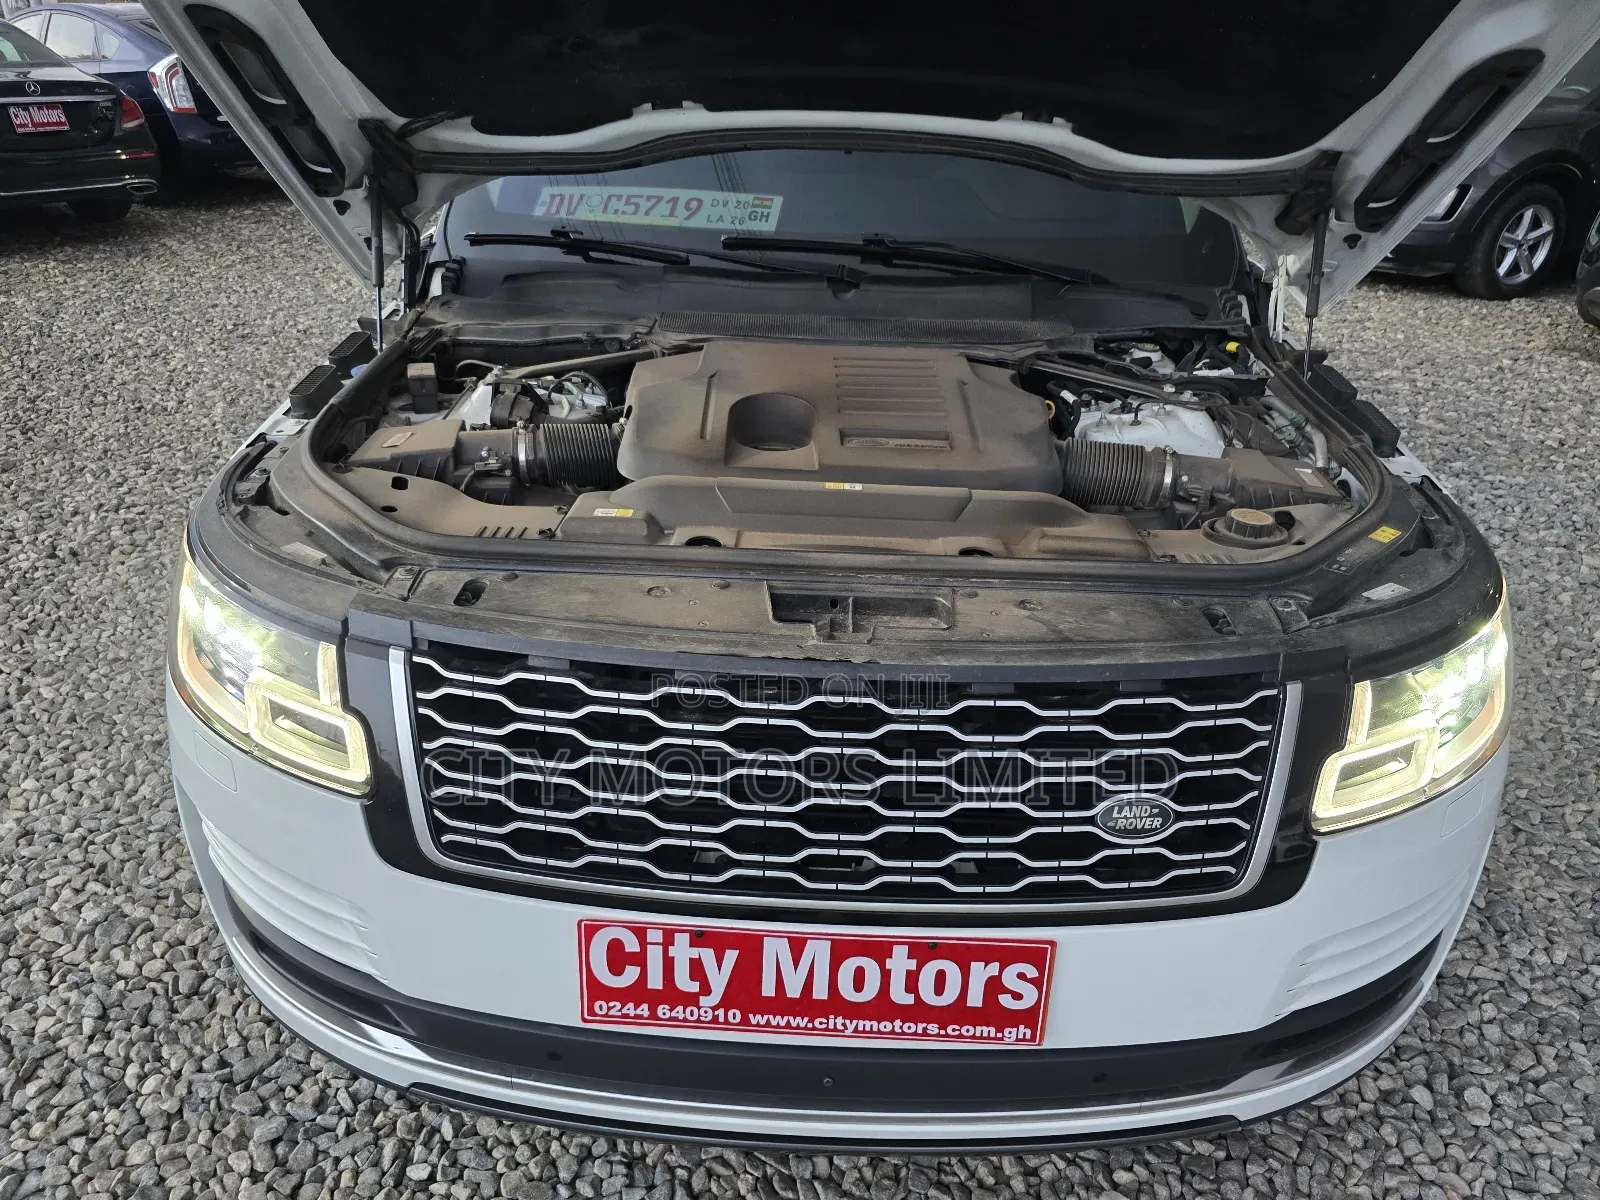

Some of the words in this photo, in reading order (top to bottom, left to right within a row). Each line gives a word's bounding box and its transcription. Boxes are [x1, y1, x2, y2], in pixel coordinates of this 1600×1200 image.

[10, 106, 32, 128] City
[29, 105, 67, 123] Motors
[545, 193, 586, 217] DV
[710, 198, 729, 208] DV
[706, 214, 724, 224] LA
[748, 210, 771, 223] GH
[1112, 806, 1151, 818] LAND
[1115, 817, 1163, 830] ROVER
[588, 926, 740, 1007] City
[761, 936, 1040, 1010] Motors
[593, 1000, 651, 1019] 0244
[656, 1004, 742, 1024] 640910
[748, 1013, 1032, 1042] www.citymotors.com.gh
